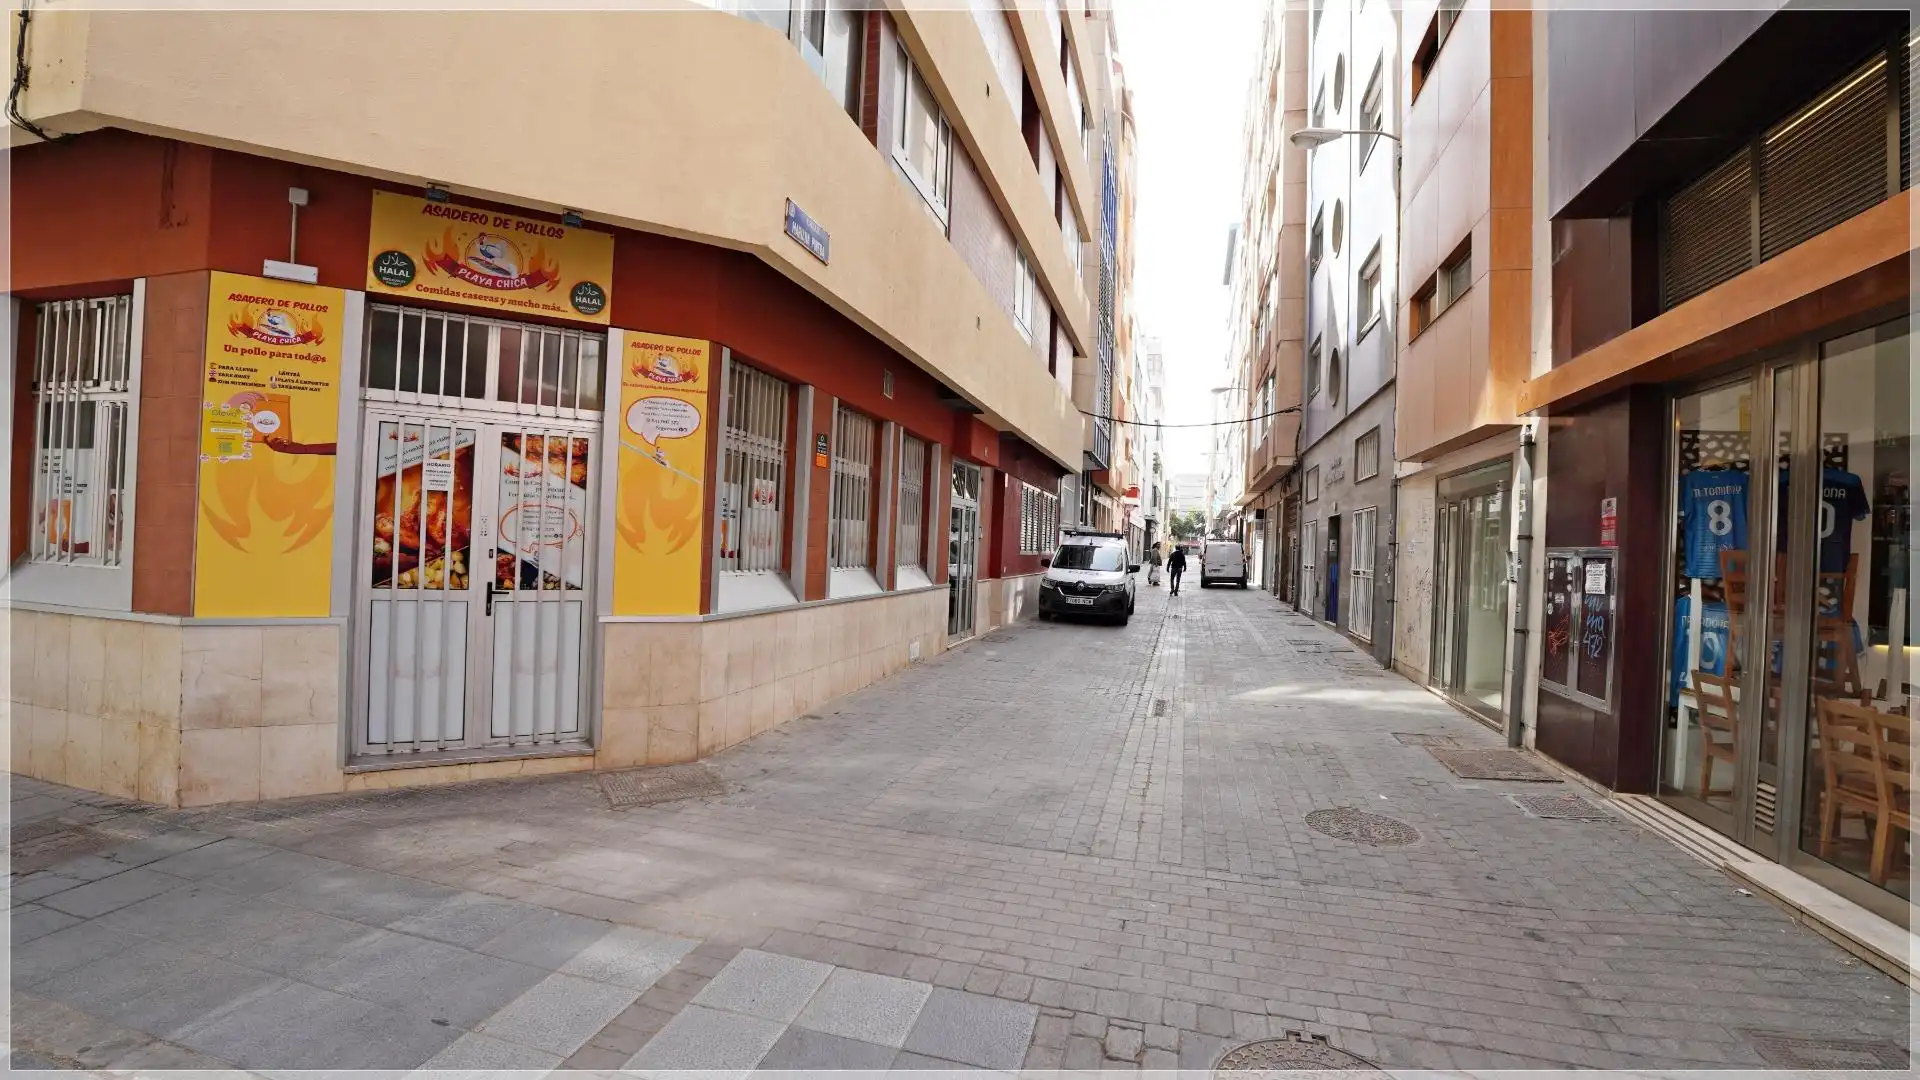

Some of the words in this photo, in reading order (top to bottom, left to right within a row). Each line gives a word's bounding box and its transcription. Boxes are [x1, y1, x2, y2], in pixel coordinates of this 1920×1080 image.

[422, 203, 488, 225] ASADERO
[493, 215, 510, 230] DE
[514, 220, 565, 240] POLLOS
[382, 253, 408, 266] حلال
[379, 266, 410, 278] HALAL
[458, 267, 493, 288] PLAYA
[496, 277, 528, 289] CHICA
[228, 292, 275, 306] ASADERO
[277, 299, 290, 308] DE
[293, 301, 329, 313] POLLOS
[415, 283, 461, 298] Comidas
[462, 290, 499, 304] caseras
[499, 296, 507, 307] y
[507, 297, 541, 310] mucho
[575, 296, 602, 306] HALAL
[252, 331, 277, 344] PLAYA
[279, 336, 302, 344] CHICA
[223, 344, 239, 353] Un
[240, 346, 268, 357] pollo
[268, 350, 293, 359] para
[294, 352, 327, 364] tod@s
[631, 341, 664, 351] ASADERO
[676, 347, 702, 355] POLLOS
[648, 372, 667, 382] PLAYA
[1707, 500, 1732, 536] 8
